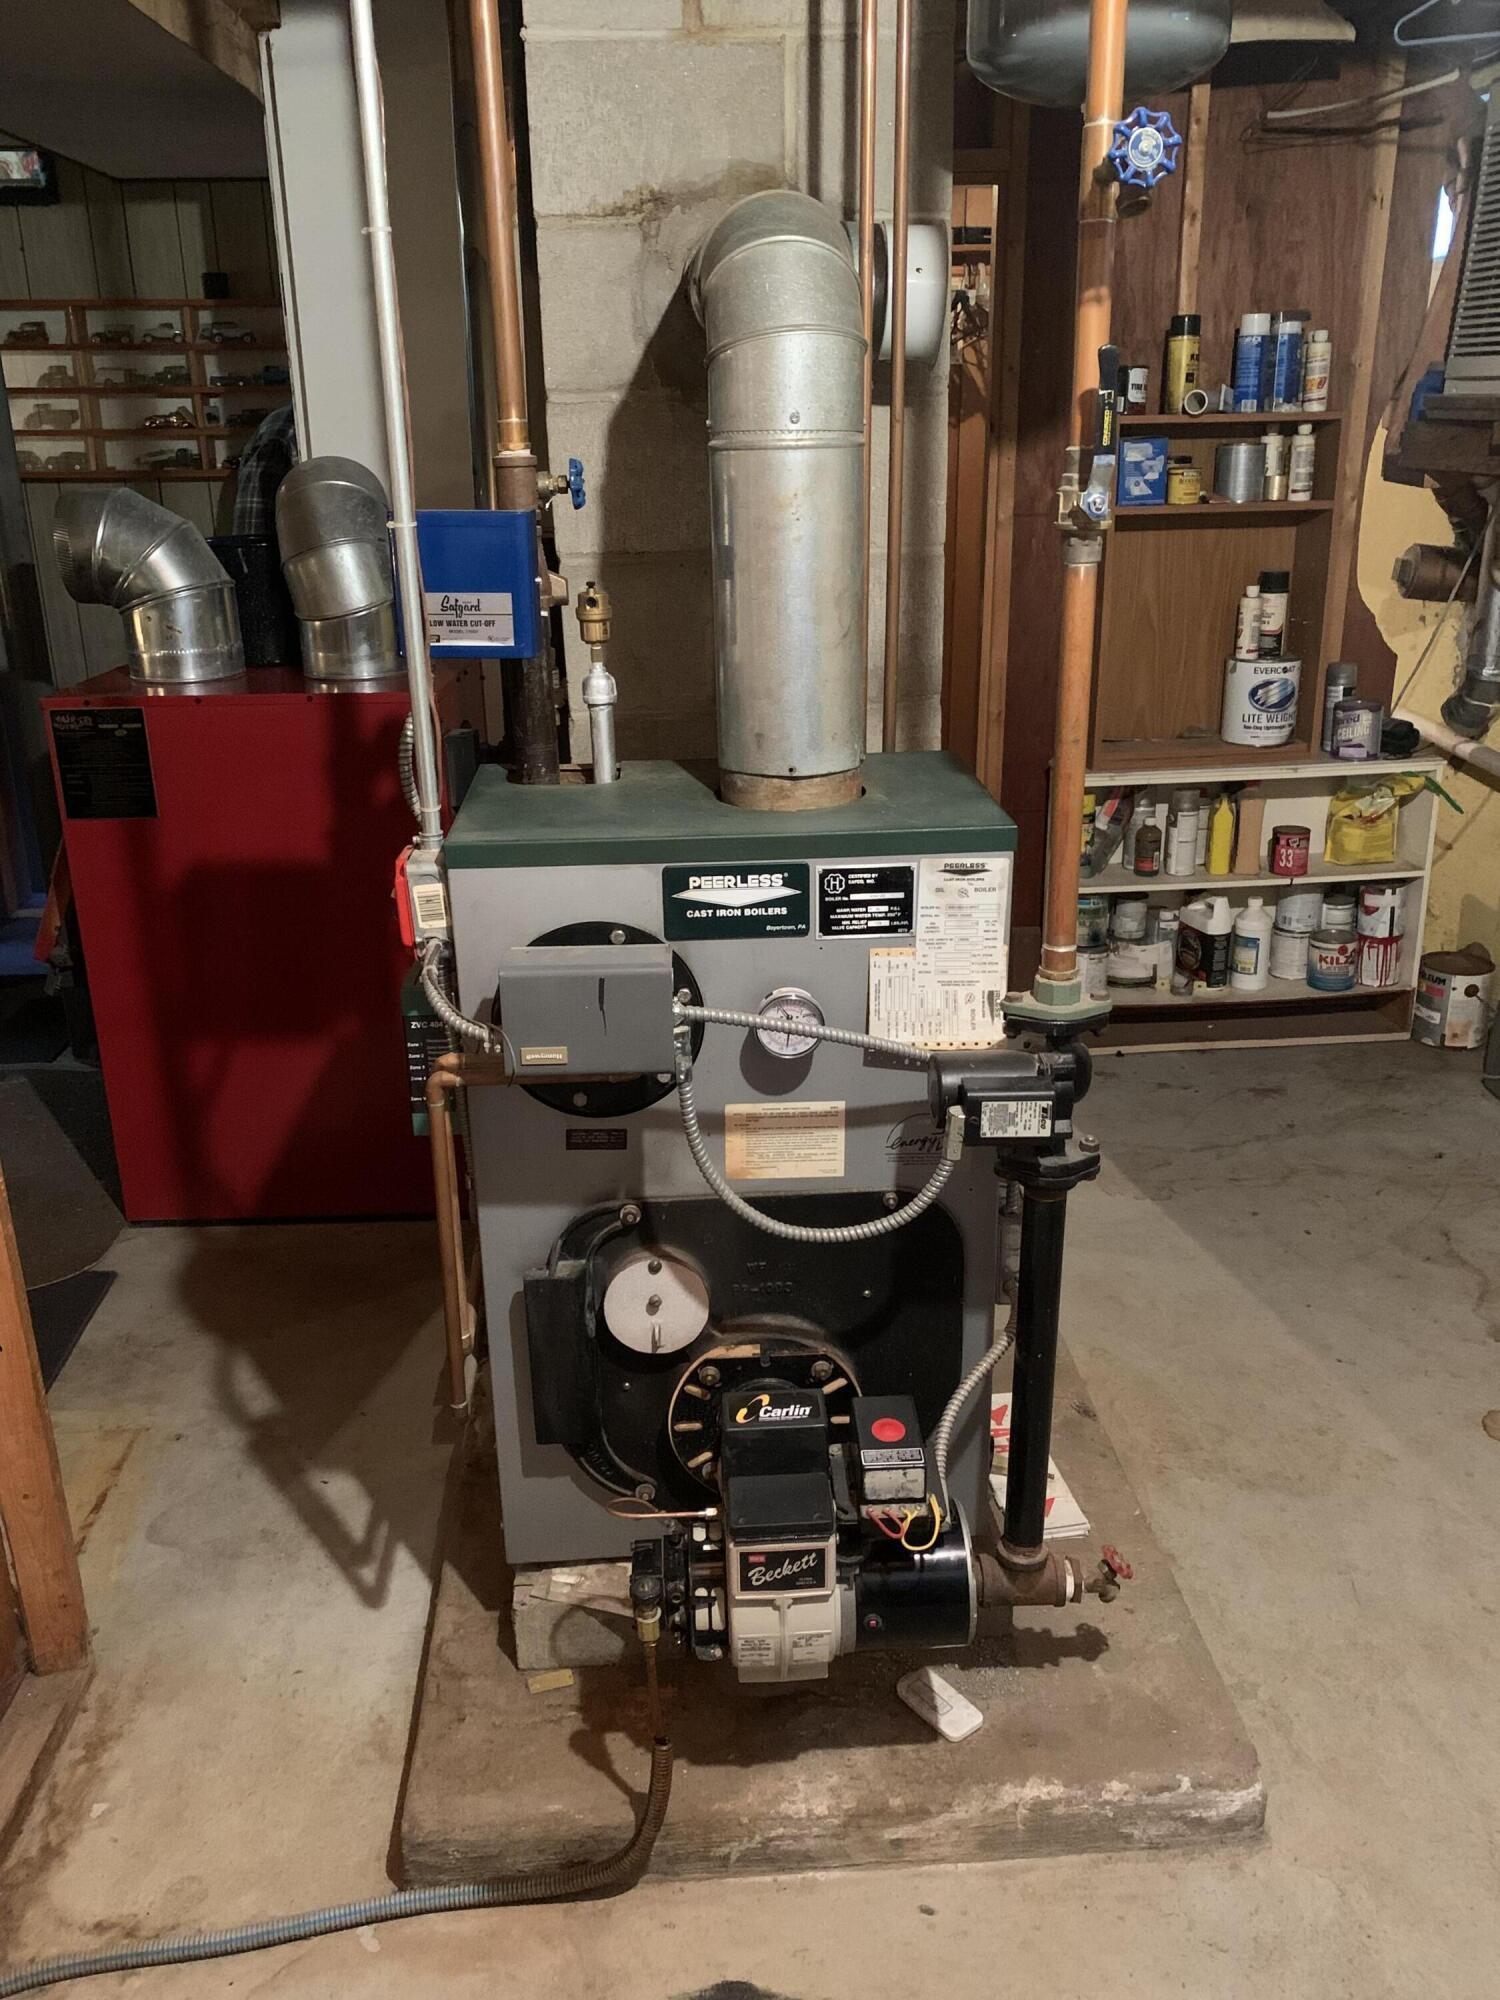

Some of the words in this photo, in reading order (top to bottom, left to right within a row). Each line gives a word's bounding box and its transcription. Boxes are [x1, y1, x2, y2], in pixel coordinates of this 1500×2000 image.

[440, 595, 481, 619] Safgard
[429, 619, 444, 627] LOW
[446, 619, 468, 627] WATER
[470, 619, 496, 627] CUT-OFF
[1242, 712, 1263, 724] LITE
[1280, 848, 1293, 868] 33
[688, 873, 784, 889] PEERLESS
[686, 909, 714, 918] CAST
[716, 908, 741, 917] IRON
[744, 907, 788, 916] BOILERS
[1318, 948, 1356, 966] KILZ
[410, 1021, 428, 1029] ZVC
[759, 1404, 812, 1417] Carlin
[747, 1552, 818, 1586] Beckett
